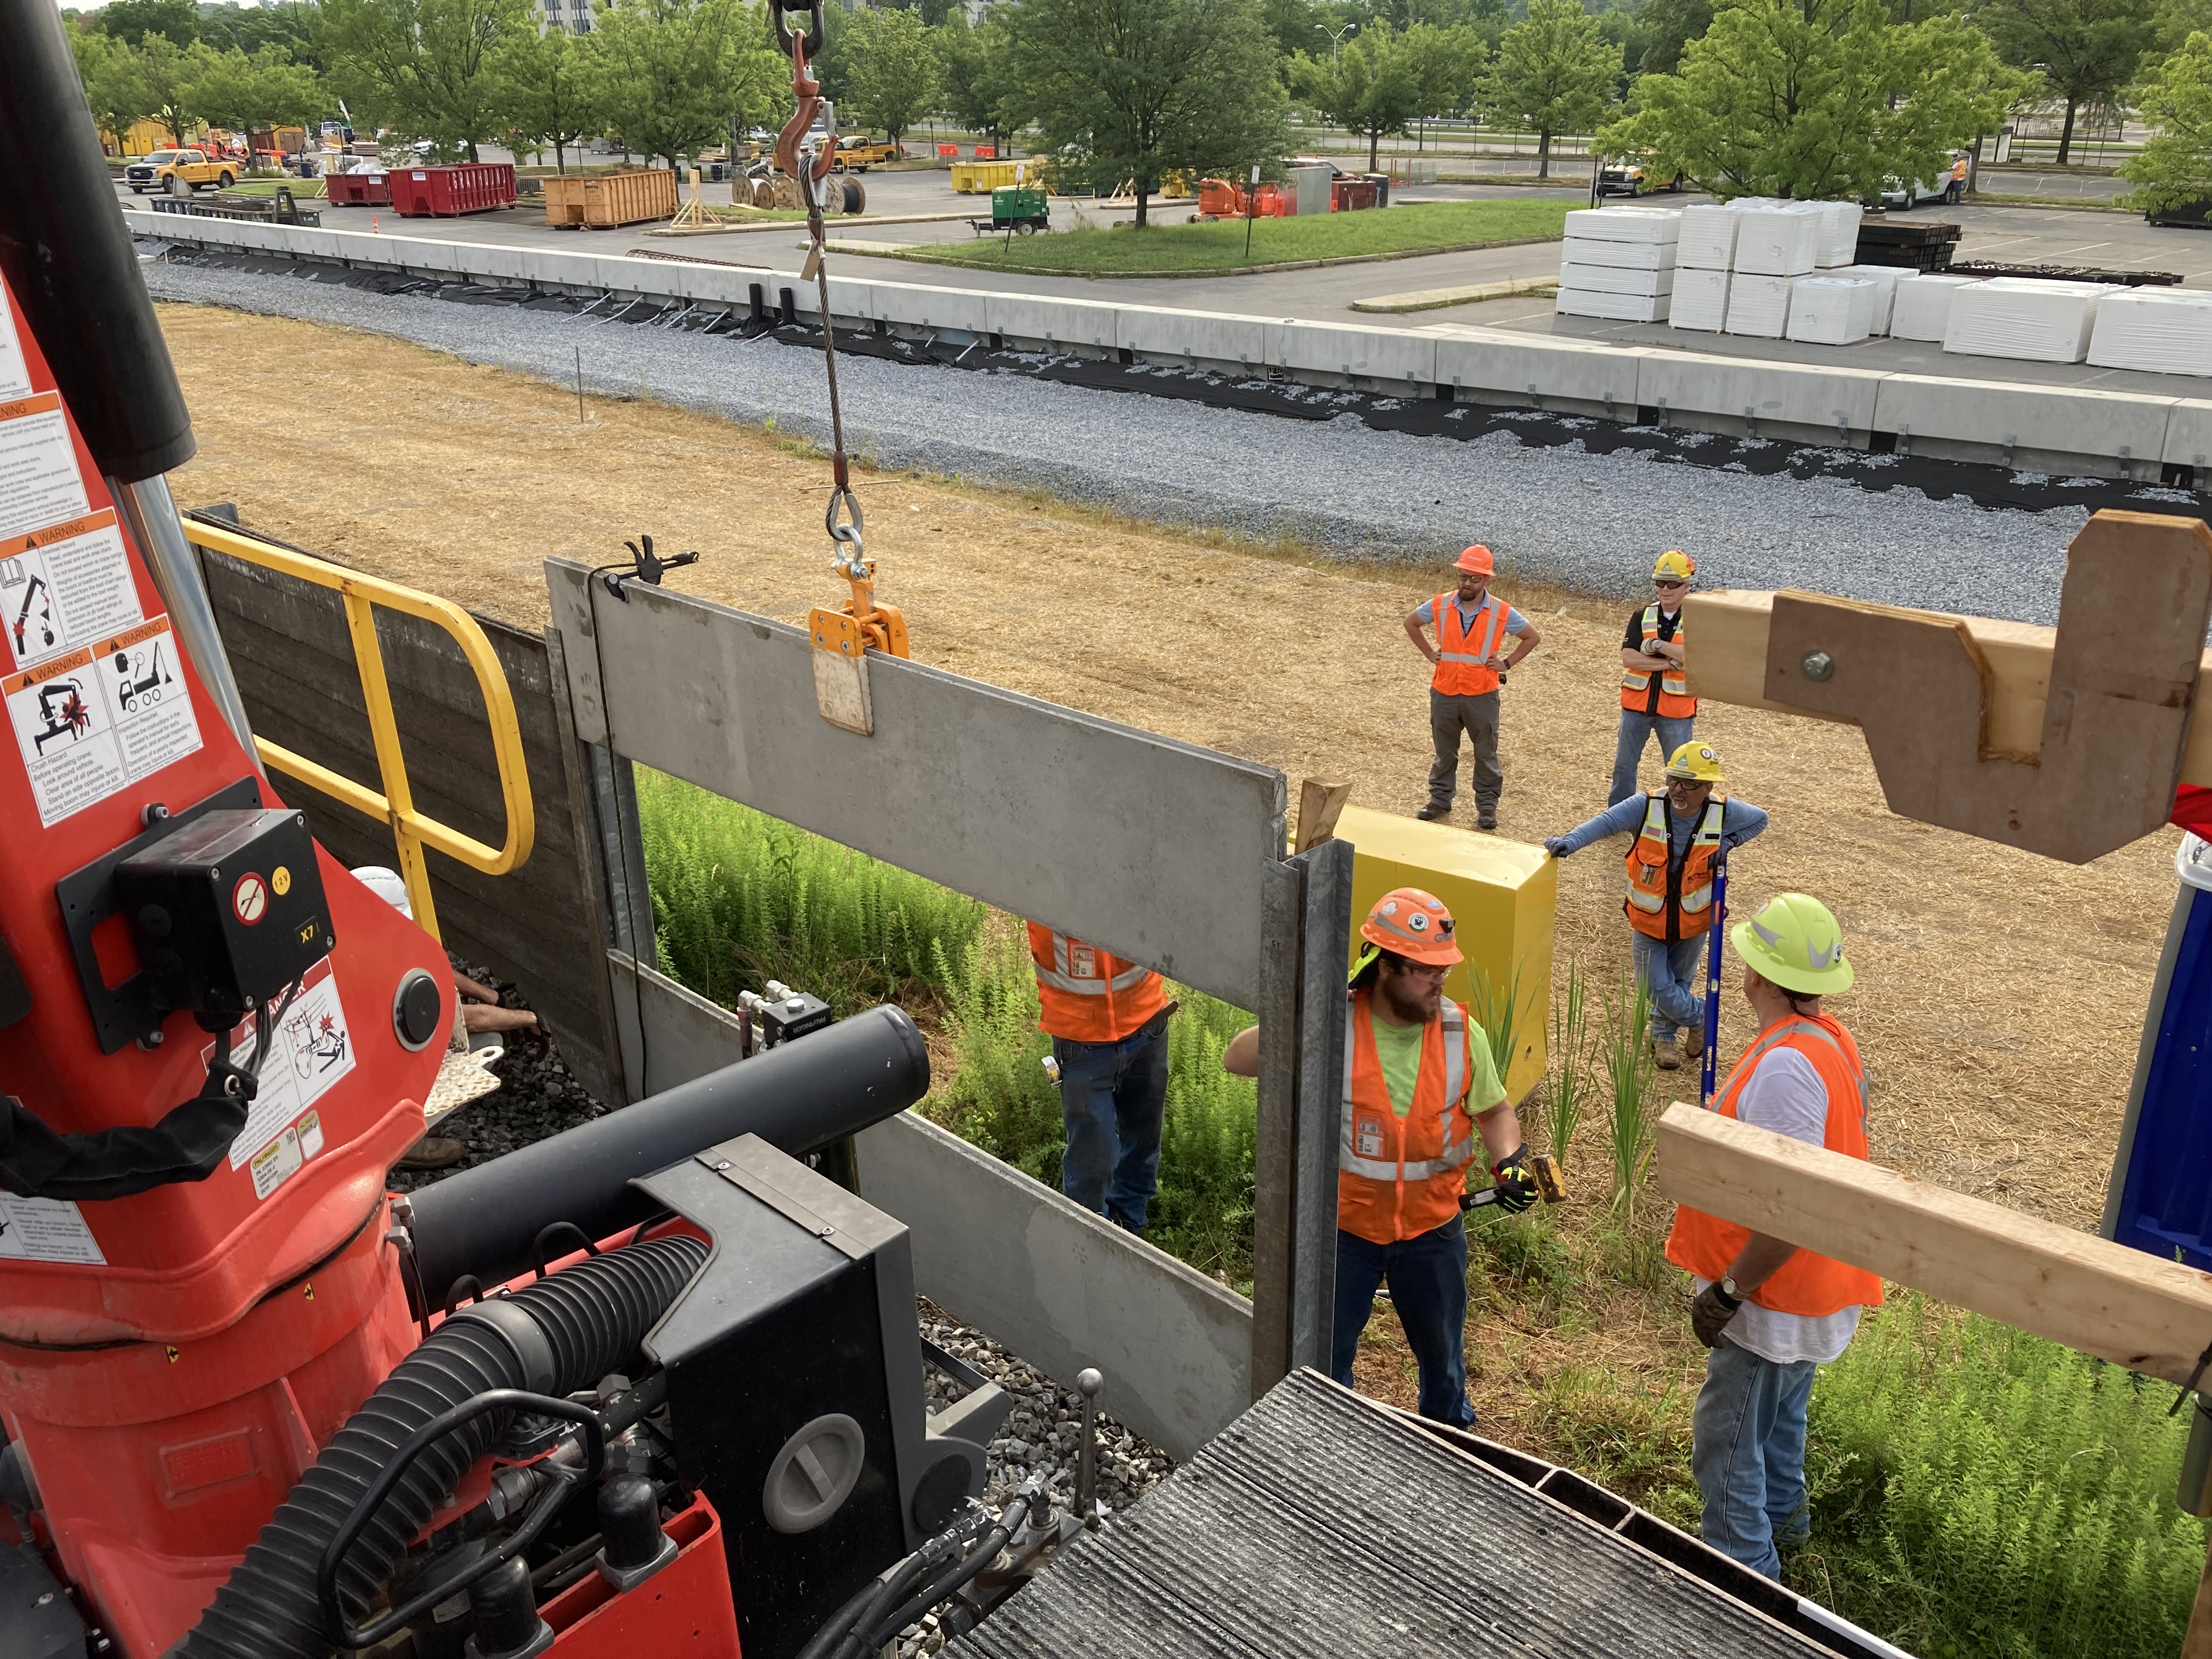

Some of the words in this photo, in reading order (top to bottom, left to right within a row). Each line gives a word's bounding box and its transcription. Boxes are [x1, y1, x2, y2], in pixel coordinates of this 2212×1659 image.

[0, 403, 27, 418] NING
[38, 522, 85, 543] WARNING
[121, 622, 161, 645] WARNING
[37, 654, 83, 680] WARNING
[30, 760, 47, 772] Crush
[47, 751, 67, 764] Hazard.
[33, 769, 51, 781] Before
[52, 758, 76, 773] operating
[42, 776, 56, 787] Look
[57, 768, 75, 780] around
[75, 759, 94, 771] vehicle.
[45, 785, 59, 795] Clear
[60, 779, 72, 788] area
[86, 764, 104, 777] people.
[48, 792, 64, 804] Stand
[72, 783, 83, 793] side
[83, 773, 104, 787] opposite
[43, 803, 63, 816] Moving
[63, 795, 78, 806] boom
[79, 789, 90, 799] may
[91, 782, 104, 793] injure
[300, 926, 314, 944] X7
[793, 1016, 826, 1034] PALFINGER
[240, 1039, 254, 1052] Hazard
[254, 1144, 278, 1167] PALFINGER
